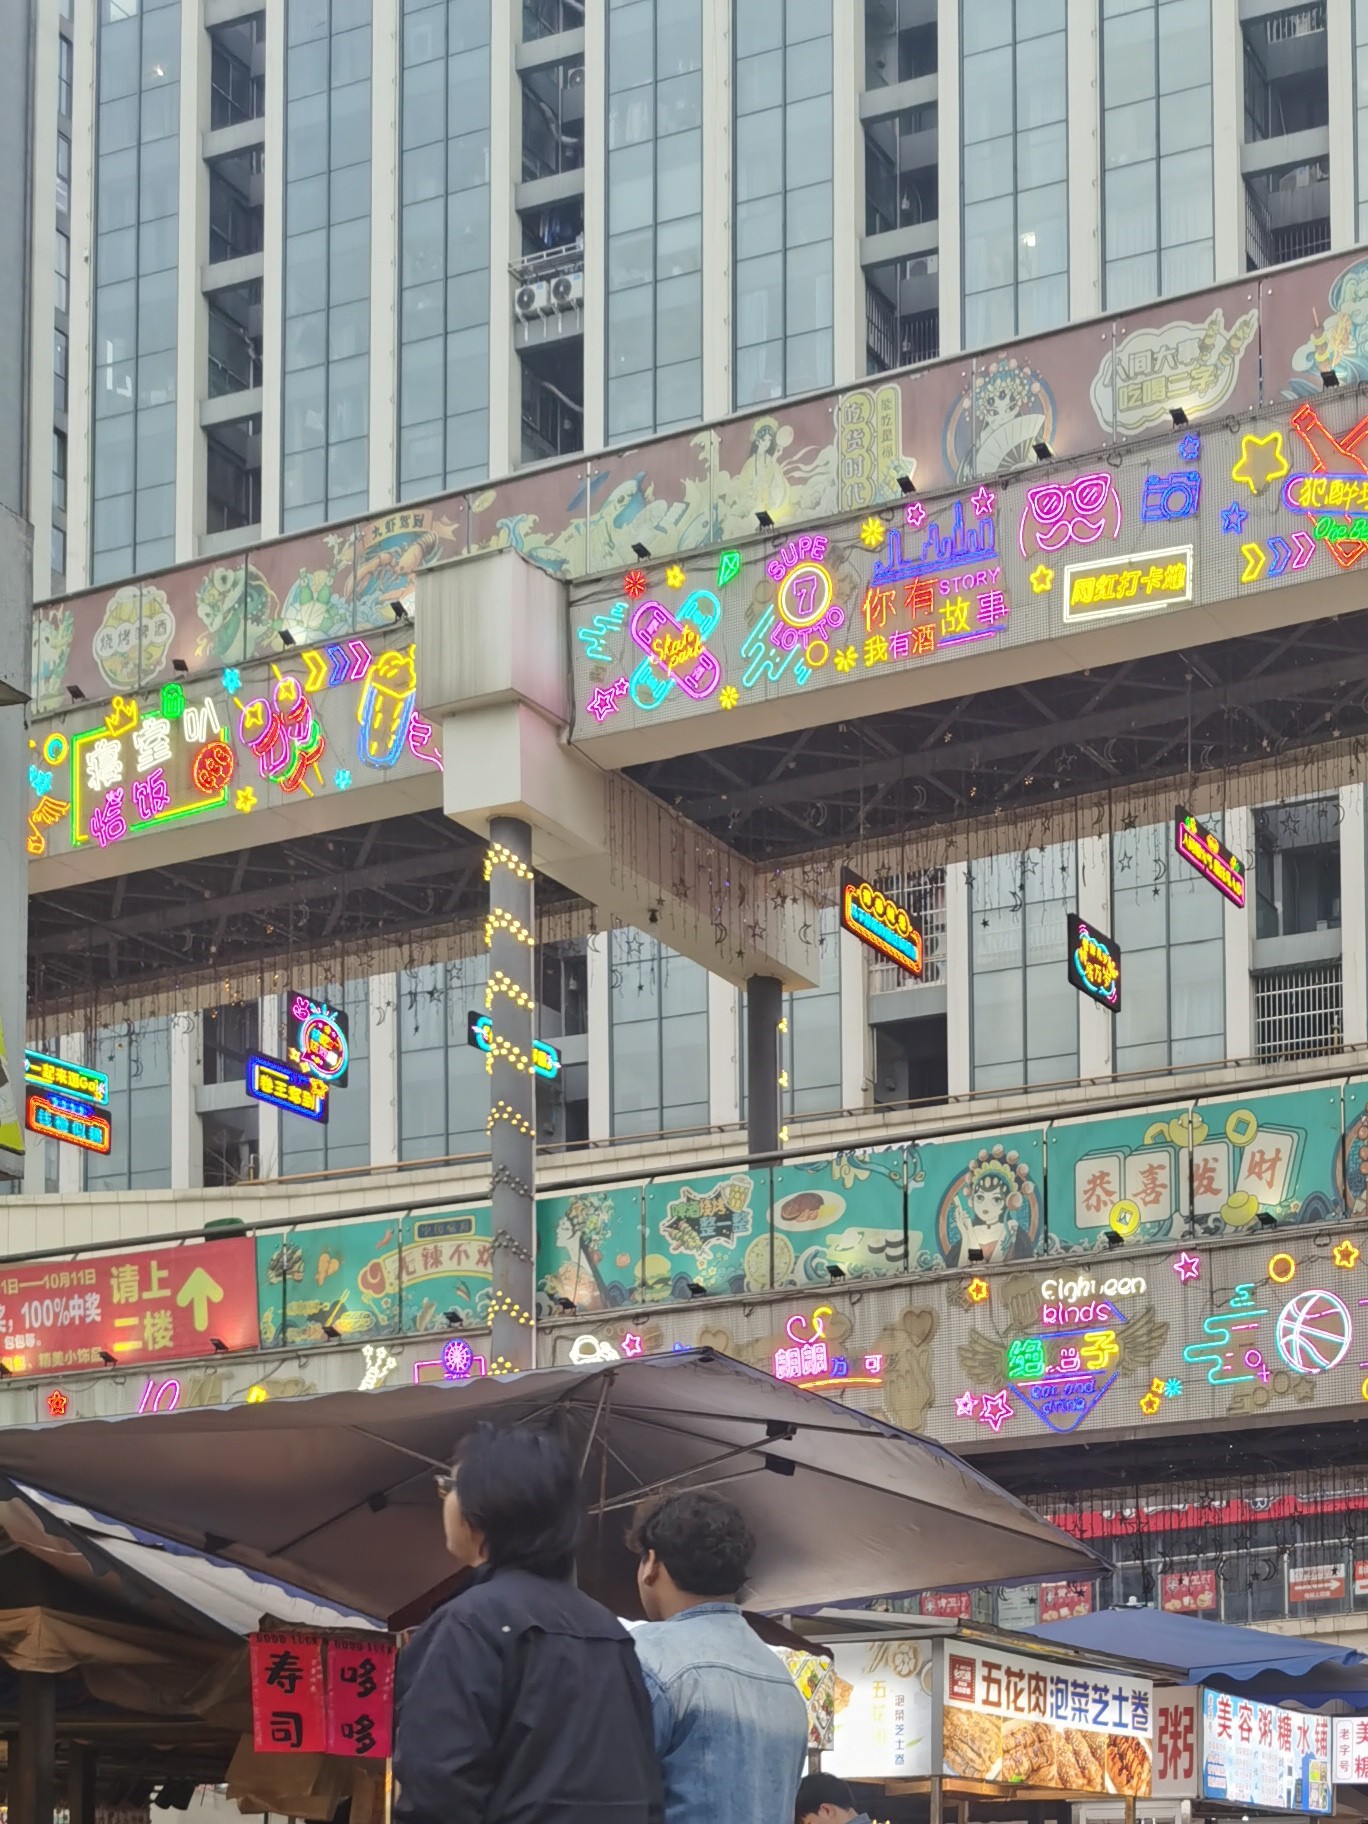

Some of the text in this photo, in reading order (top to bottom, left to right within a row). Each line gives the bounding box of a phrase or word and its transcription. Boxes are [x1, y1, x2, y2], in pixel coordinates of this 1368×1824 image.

[1103, 337, 1206, 385] 人间大事
[1117, 363, 1218, 411] 吃喝二字
[843, 402, 865, 506] 吃货时代
[793, 576, 818, 614] 7
[939, 567, 1001, 596] STORY
[100, 618, 167, 652] 烧烤啤酒
[652, 624, 697, 664] Skate
[770, 605, 845, 652] LOTTO
[864, 623, 936, 668] 我有酒
[667, 635, 704, 675] park
[91, 768, 170, 847] 恰饭
[110, 1259, 171, 1305] 请上
[113, 1309, 174, 1352] 二楼
[265, 1651, 303, 1748] 寿司
[341, 1659, 376, 1754] 哆哆
[981, 1660, 1149, 1731] 五花肉泡菜芝士卷
[1158, 1705, 1194, 1780] 粥
[1217, 1697, 1328, 1757] 美容粥糖水铺
[1339, 1729, 1350, 1773] 老字号
